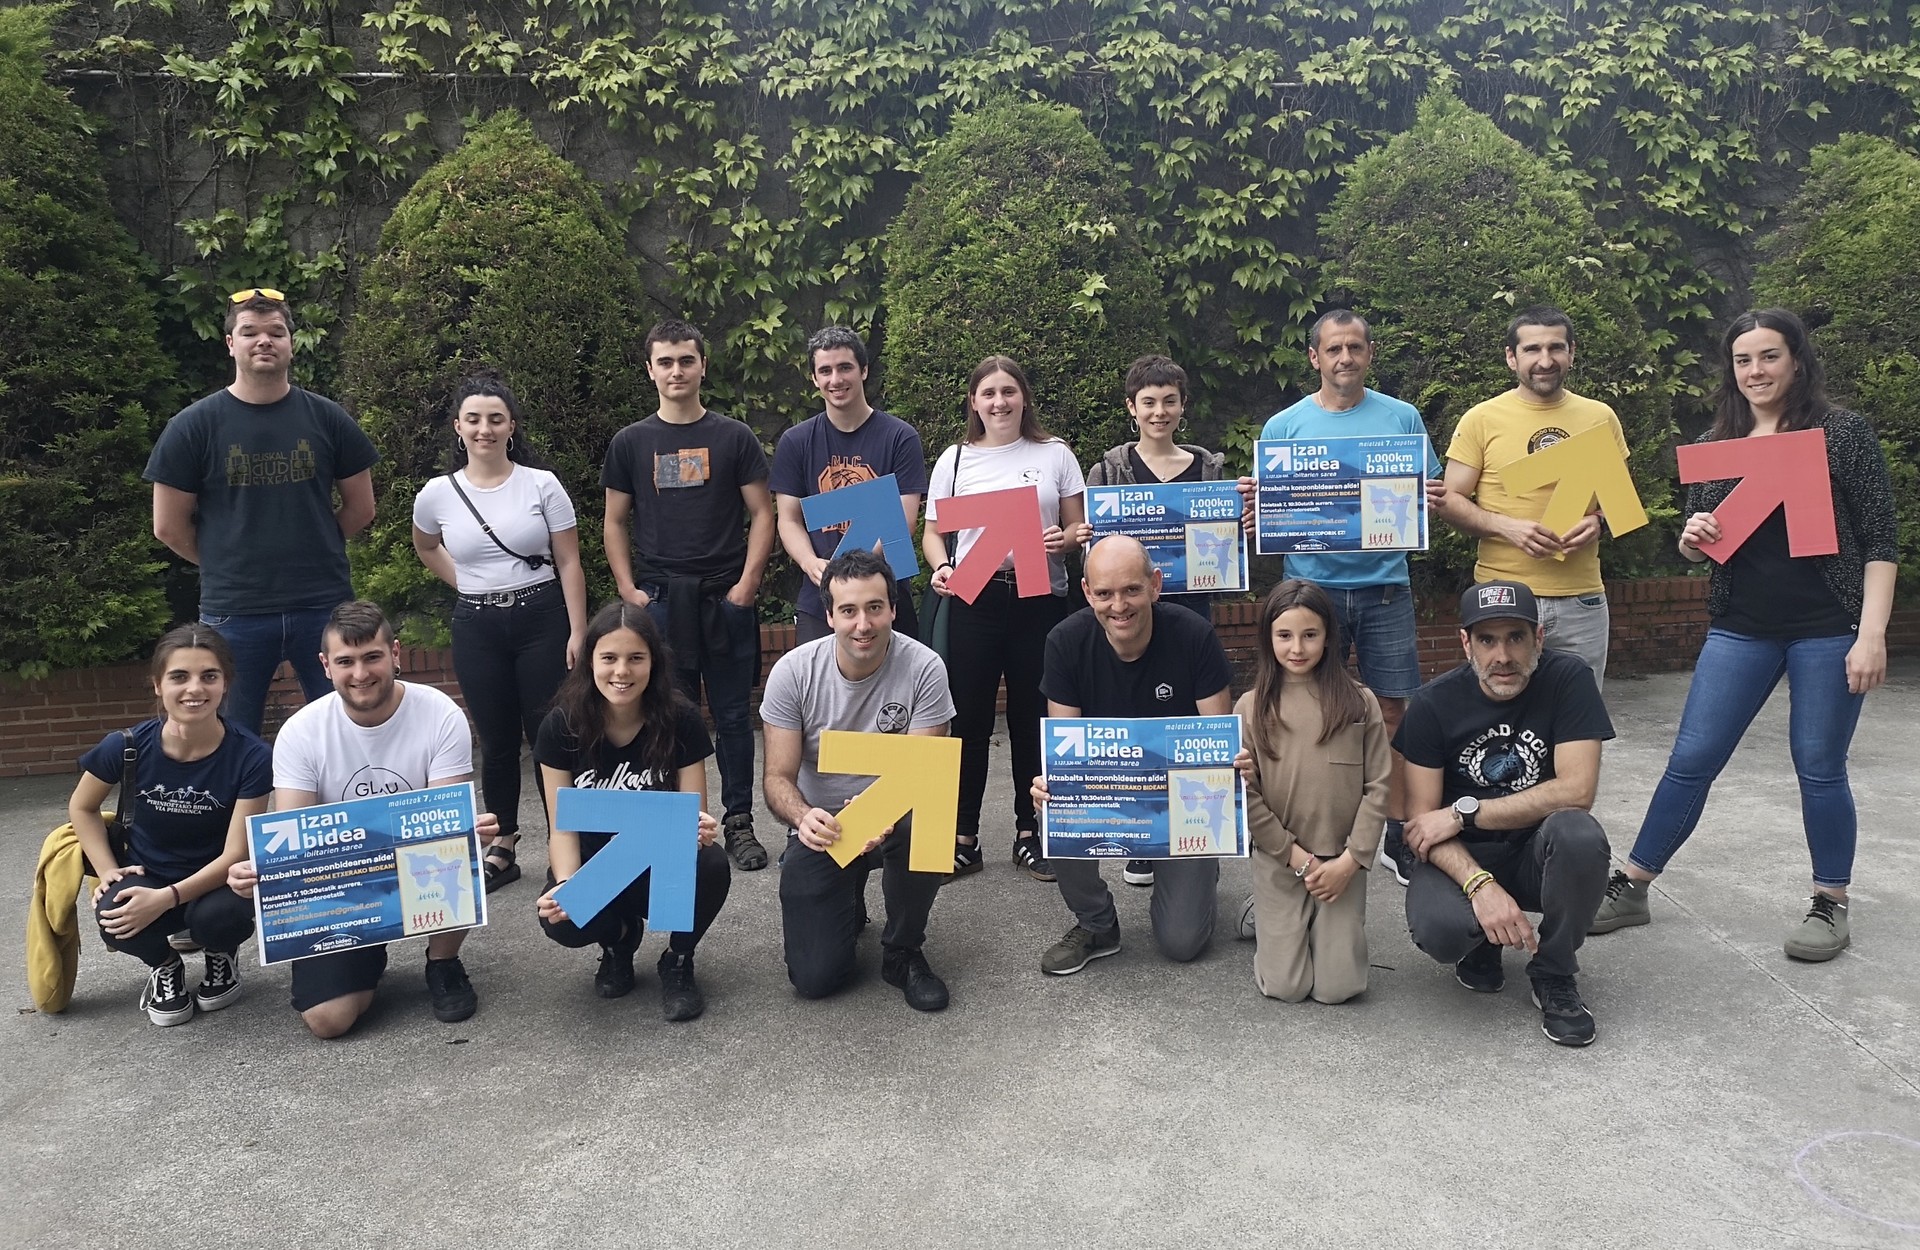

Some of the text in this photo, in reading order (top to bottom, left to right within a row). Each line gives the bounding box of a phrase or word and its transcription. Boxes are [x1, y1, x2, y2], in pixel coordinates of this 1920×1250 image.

[253, 452, 287, 462] EUSKAL
[1293, 444, 1327, 456] izan
[1294, 458, 1340, 471] bidea
[1366, 452, 1413, 463] 1.000km
[1366, 462, 1414, 473] baietz
[253, 475, 288, 485] ETXEA
[1121, 489, 1153, 502] izan
[1122, 503, 1165, 516] bidea
[1190, 498, 1233, 508] 1.000km
[1190, 507, 1234, 518] baietz
[1087, 724, 1128, 739] izan
[1088, 742, 1143, 758] bidea
[1174, 738, 1228, 750] 1.000km
[1459, 724, 1514, 765] BRIGAD
[1175, 749, 1230, 762] baietz
[1085, 774, 1148, 783] konponbidearen
[388, 797, 421, 808] maiatzak
[434, 790, 462, 800] zapatua
[301, 811, 348, 829] izan
[400, 808, 459, 826] 1.000km
[401, 820, 461, 839] baietz
[303, 828, 366, 849] bidea
[304, 844, 362, 858] ibiltarien sarea
[260, 853, 394, 882] Atxabalta konponbidearen alde!
[303, 863, 396, 884] 1000KM ETXERAKO BIDEAN!
[262, 893, 292, 902] Maiatzak
[300, 885, 336, 896] 10:30etatik
[337, 881, 362, 890] aurrera,
[263, 892, 345, 910] Koruetako miradoreetatik
[272, 901, 382, 925] atxabaltakosare@gmail.com
[266, 932, 302, 942] ETXERAKO
[304, 925, 330, 935] BIDEAN
[330, 919, 369, 930] OZTOPORIK
